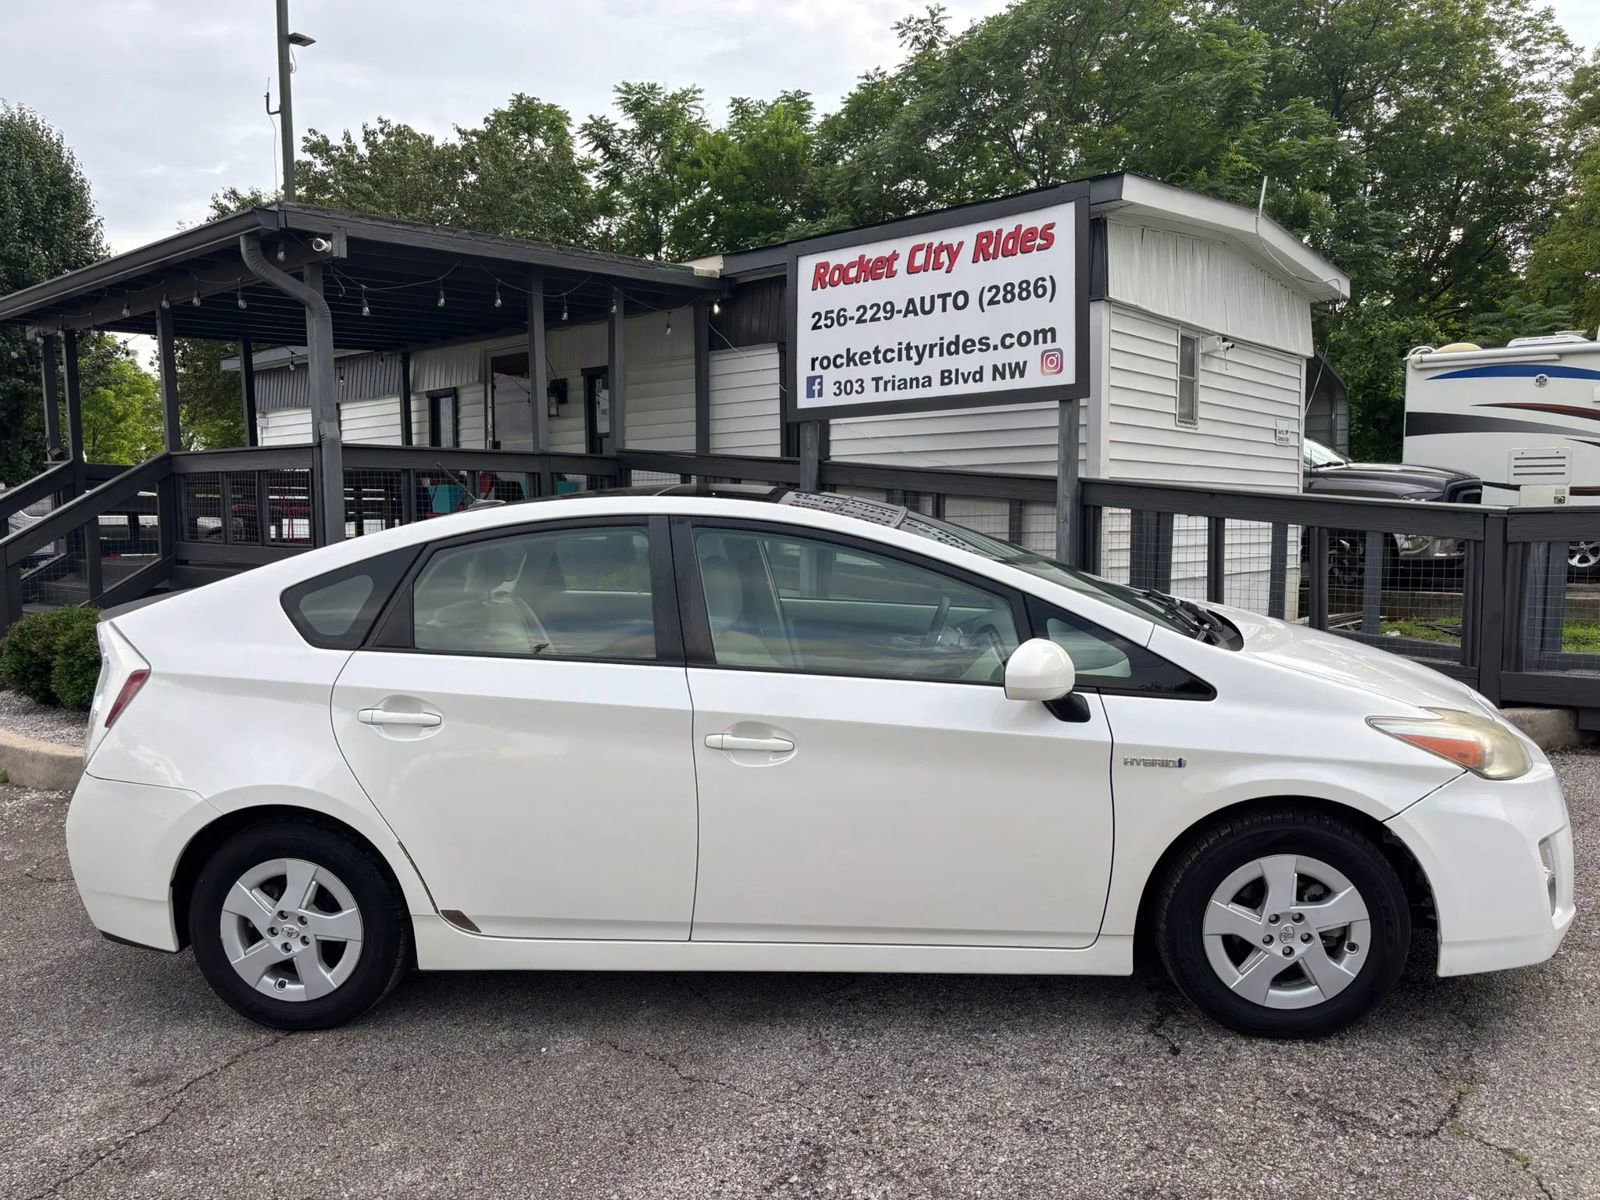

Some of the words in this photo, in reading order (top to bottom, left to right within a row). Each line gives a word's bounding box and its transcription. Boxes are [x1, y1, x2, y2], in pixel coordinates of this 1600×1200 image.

[811, 250, 900, 291] Rocket
[907, 241, 964, 274] City
[972, 222, 1056, 264] Rides
[811, 290, 969, 331] 256-229-AUTO
[978, 275, 1056, 312] (2886)
[810, 327, 1056, 371] rocketcityrides.com
[832, 379, 865, 397] 303
[871, 374, 933, 393] Triana
[939, 366, 984, 387] Blvd
[991, 360, 1028, 381] NW
[1123, 757, 1176, 768] HYBRID
